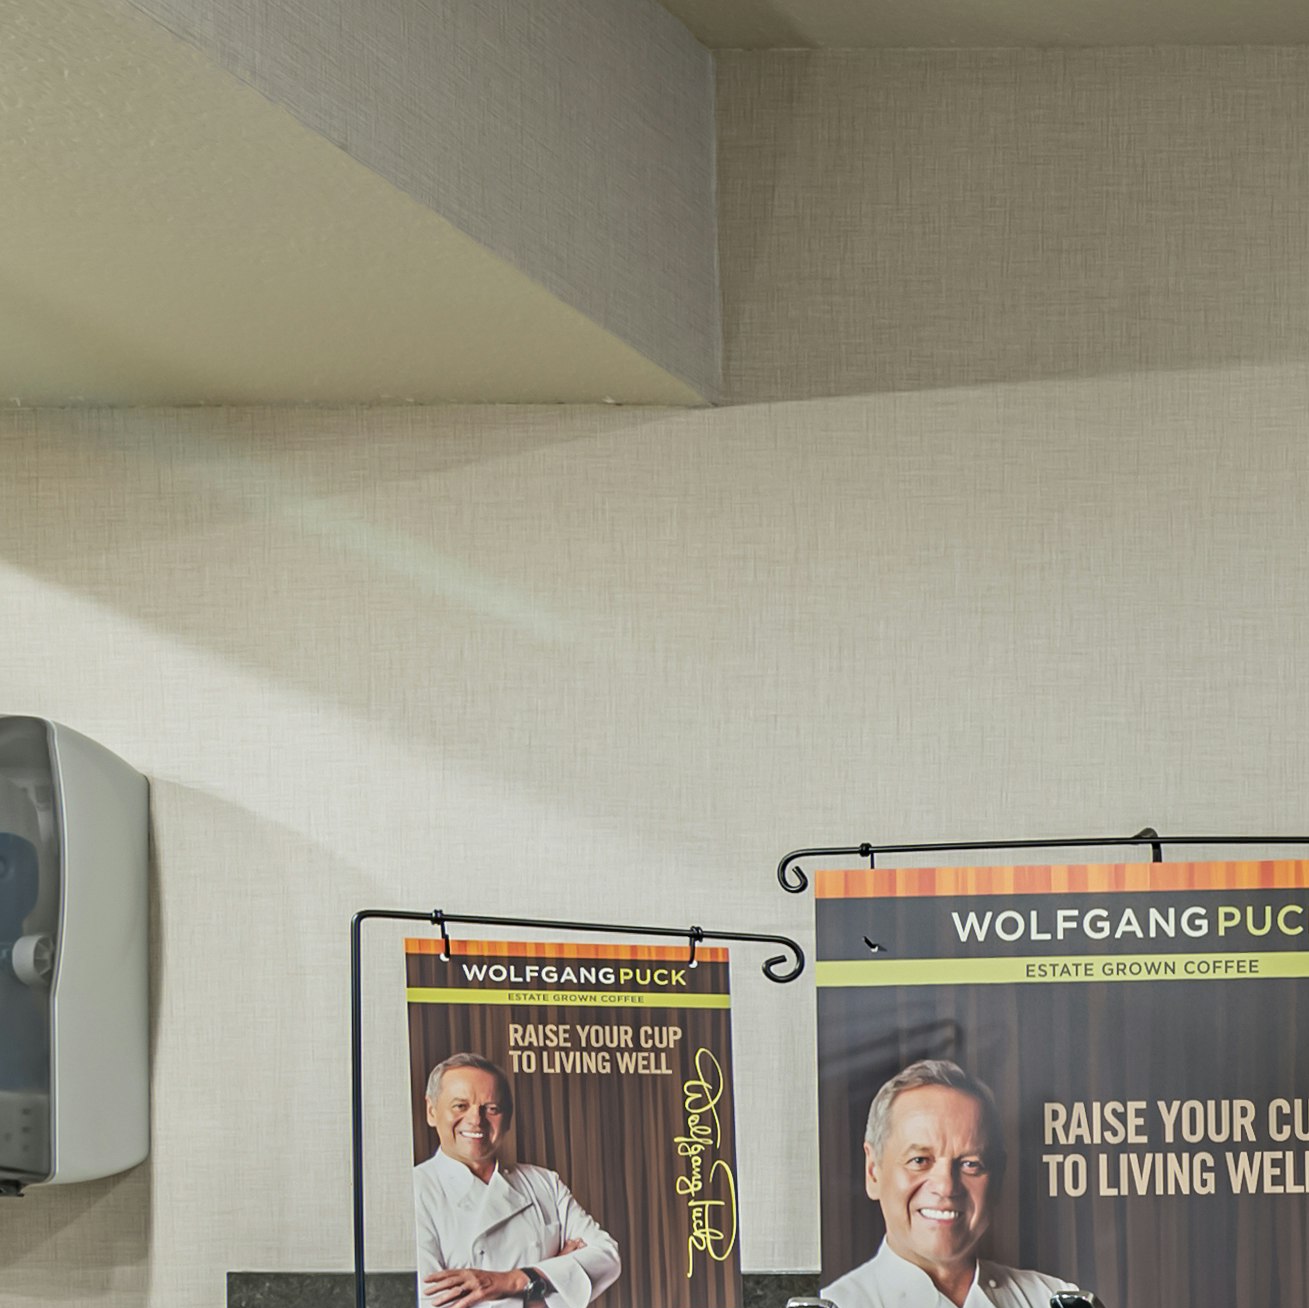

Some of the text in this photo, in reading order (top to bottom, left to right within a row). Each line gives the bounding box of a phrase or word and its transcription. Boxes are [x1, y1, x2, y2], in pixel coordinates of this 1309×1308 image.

[1025, 959, 1260, 978] ESTATE GROWN COFFEE
[507, 992, 645, 1004] ESTATE GROWN COFFEE
[508, 1023, 682, 1049] RAISE YOUR CUP
[508, 1050, 673, 1075] TO LIVING WELL
[673, 1047, 724, 1197] Wolfgang
[1043, 1100, 1149, 1145] RAISE
[1156, 1099, 1257, 1144] YOUR
[1042, 1153, 1087, 1197] TO
[1099, 1151, 1216, 1196] LIVING
